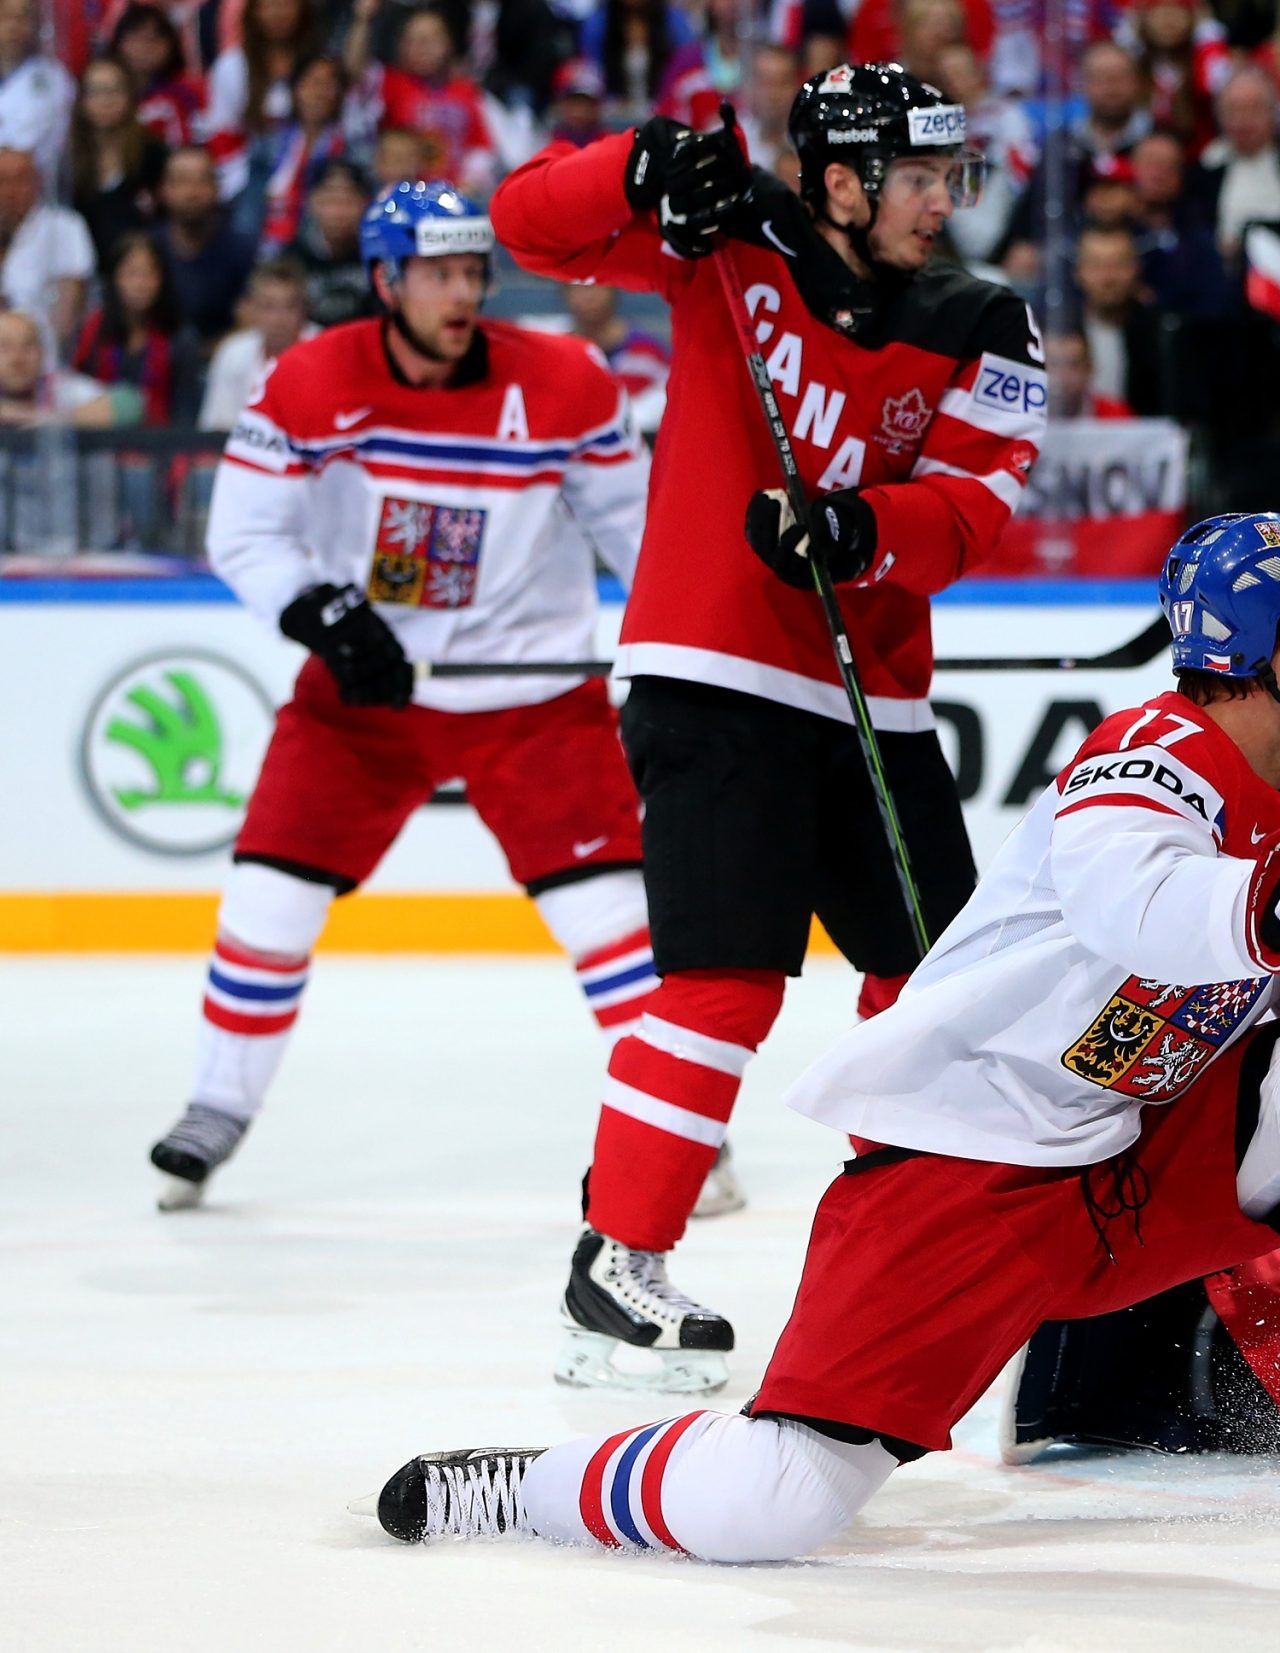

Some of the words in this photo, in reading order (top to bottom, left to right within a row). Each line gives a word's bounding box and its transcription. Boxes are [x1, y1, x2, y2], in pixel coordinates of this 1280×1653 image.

[827, 127, 879, 145] Reebok
[496, 383, 530, 441] A
[1172, 601, 1194, 634] 17
[1118, 708, 1205, 751] 17
[1064, 759, 1210, 822] ŠKODA
